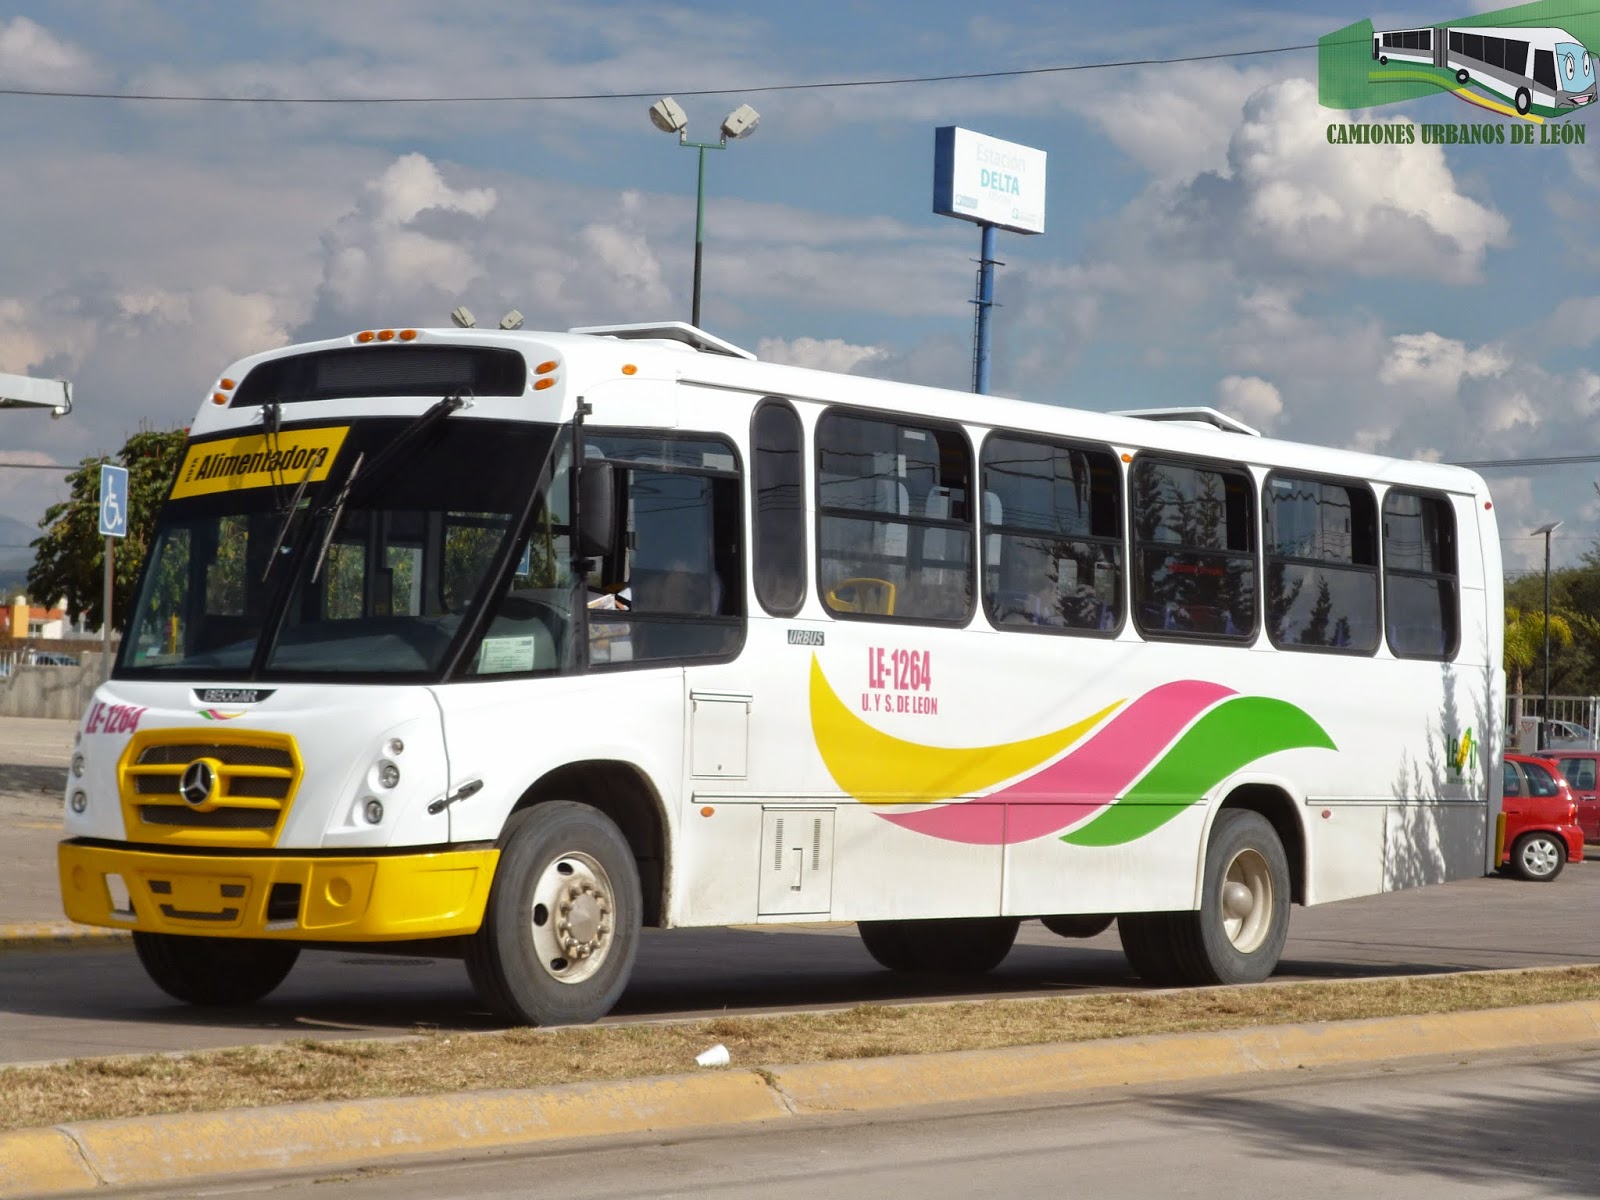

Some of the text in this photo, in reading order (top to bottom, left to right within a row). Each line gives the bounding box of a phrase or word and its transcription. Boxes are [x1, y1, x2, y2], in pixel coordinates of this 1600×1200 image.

[976, 143, 1026, 174] Estación
[980, 168, 1020, 196] DELTA
[194, 445, 329, 481] Alimentadora
[788, 629, 825, 646] URBUS
[869, 647, 931, 691] LE-1264
[85, 702, 149, 734] LE-1264
[861, 693, 938, 715] U. Y S. DE LEON
